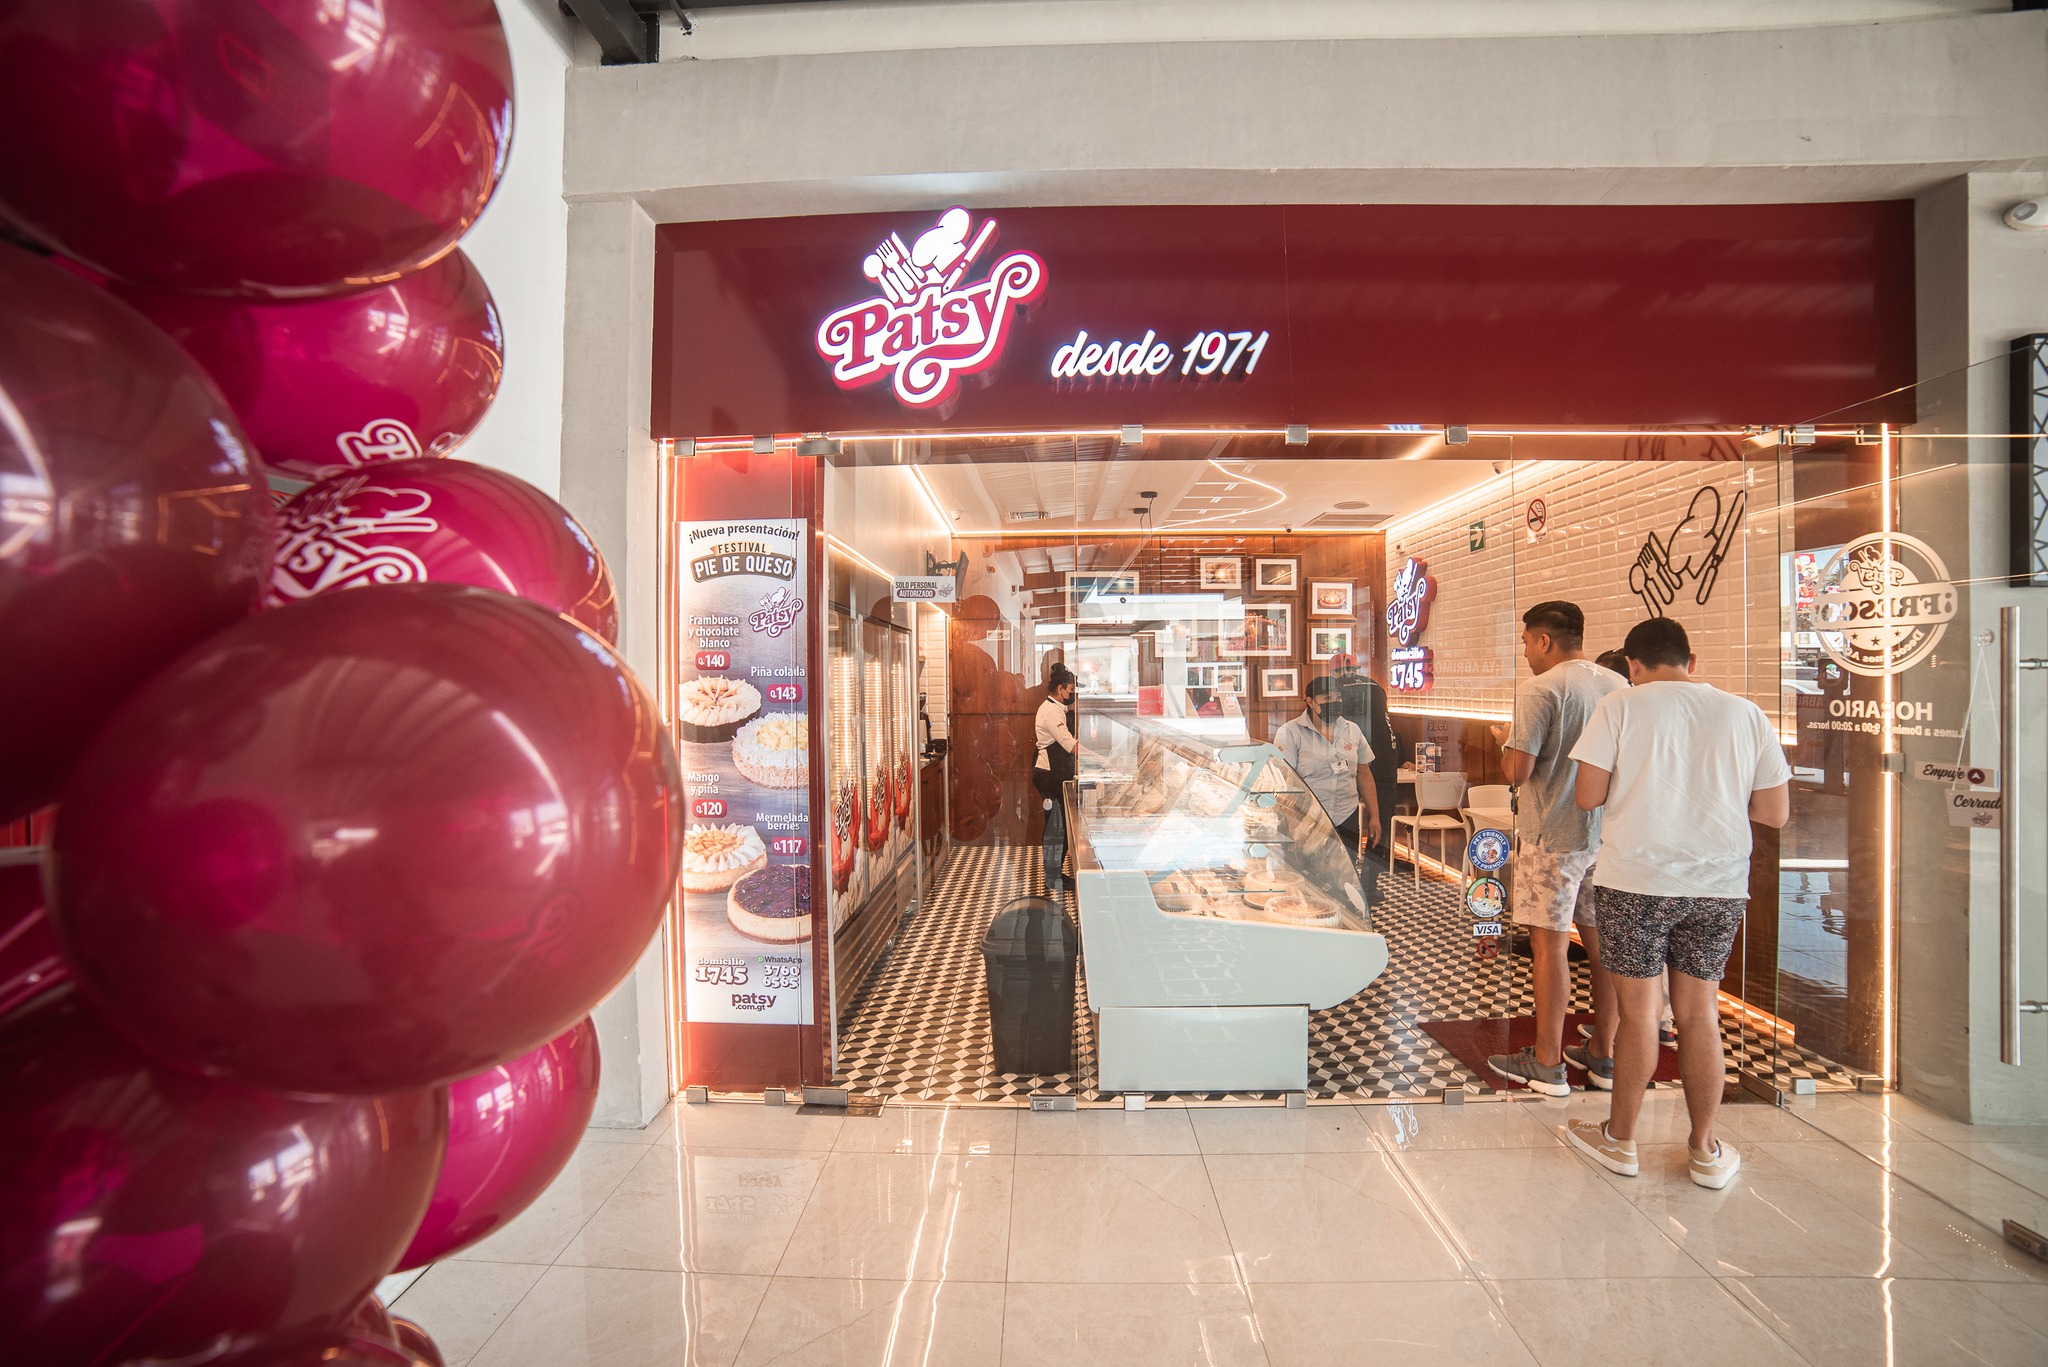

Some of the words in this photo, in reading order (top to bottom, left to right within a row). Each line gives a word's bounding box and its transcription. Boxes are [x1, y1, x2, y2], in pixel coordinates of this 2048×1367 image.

[818, 252, 1046, 404] Patsy
[1052, 329, 1174, 378] desde
[1183, 330, 1270, 375] 1971
[688, 525, 725, 545] ¡Nueva
[727, 524, 800, 541] presentación!
[717, 543, 767, 554] FESTIVAL
[694, 559, 717, 579] PIE
[722, 556, 740, 574] DE
[745, 555, 793, 577] QUESO
[895, 581, 909, 589] SOLO
[910, 581, 938, 589] PERSONAL
[898, 589, 934, 598] AUTORIZADO
[748, 597, 803, 638] Patsy
[1387, 578, 1427, 646] Patsy
[688, 614, 739, 626] Frambuesa
[688, 628, 695, 638] y
[696, 625, 739, 637] chocolate
[699, 637, 730, 648] blanco
[751, 665, 773, 677] Piña
[774, 665, 806, 677] colada
[1390, 662, 1425, 690] 1745
[688, 772, 720, 784] Mango
[1923, 764, 1967, 782] Empuje
[690, 785, 697, 795] y
[697, 783, 719, 796] piña
[1953, 795, 2002, 810] Cerrad
[756, 812, 808, 823] Mermelada
[767, 820, 800, 831] berries
[1473, 834, 1483, 846] PET
[1482, 831, 1507, 846] FRIENDLY
[1472, 855, 1482, 867] PET
[1480, 857, 1505, 870] FRIENDLY
[1476, 925, 1499, 934] VISA
[697, 957, 746, 966] domicilio
[764, 955, 803, 965] WhatsApp
[695, 965, 748, 985] 1745
[762, 965, 800, 977] 3760
[761, 976, 800, 988] 6565
[731, 992, 777, 1008] patsy
[735, 1003, 766, 1012] .com.gt
